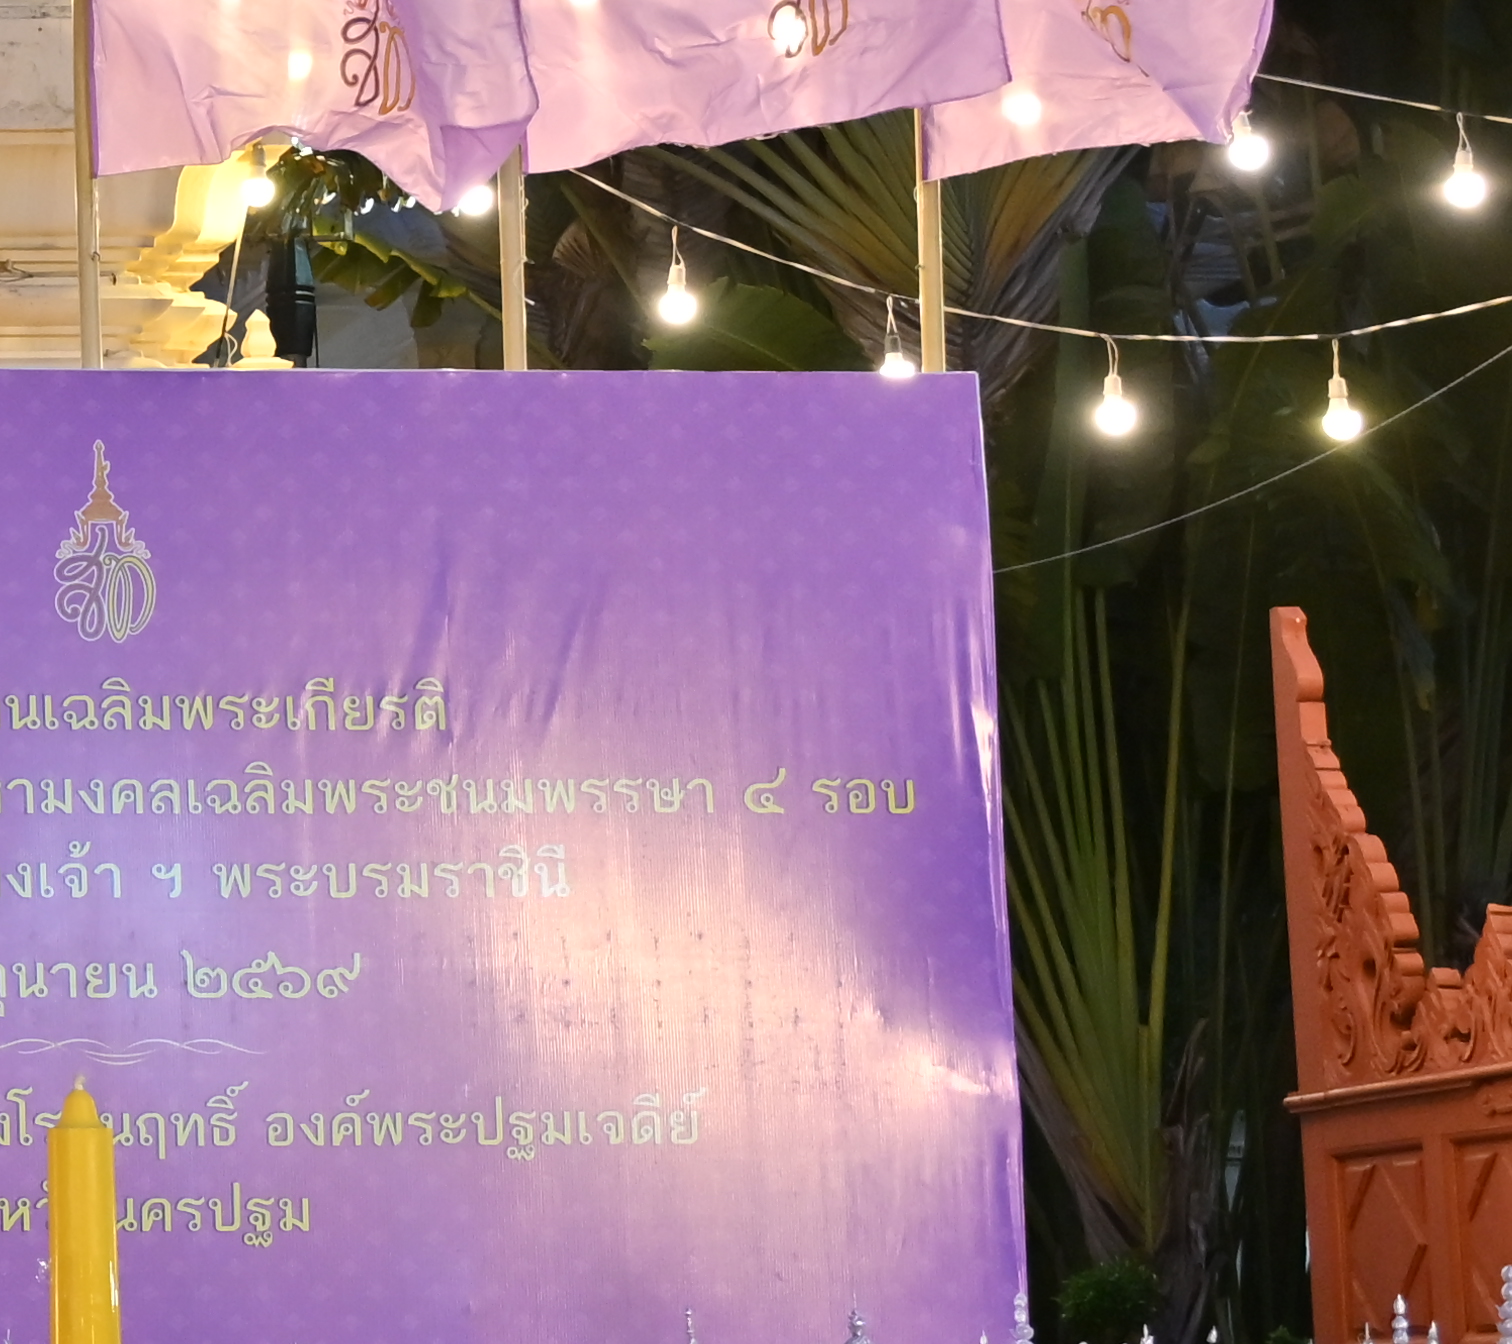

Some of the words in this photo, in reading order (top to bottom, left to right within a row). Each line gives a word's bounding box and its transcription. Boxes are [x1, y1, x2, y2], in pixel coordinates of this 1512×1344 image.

[742, 767, 788, 814] ๔
[812, 776, 917, 814] รอบ
[214, 844, 571, 899] พระบรมราชินี
[179, 949, 362, 1000] ๒๕๖๙
[264, 1088, 708, 1161] องค์พระปฐมเจดีย์
